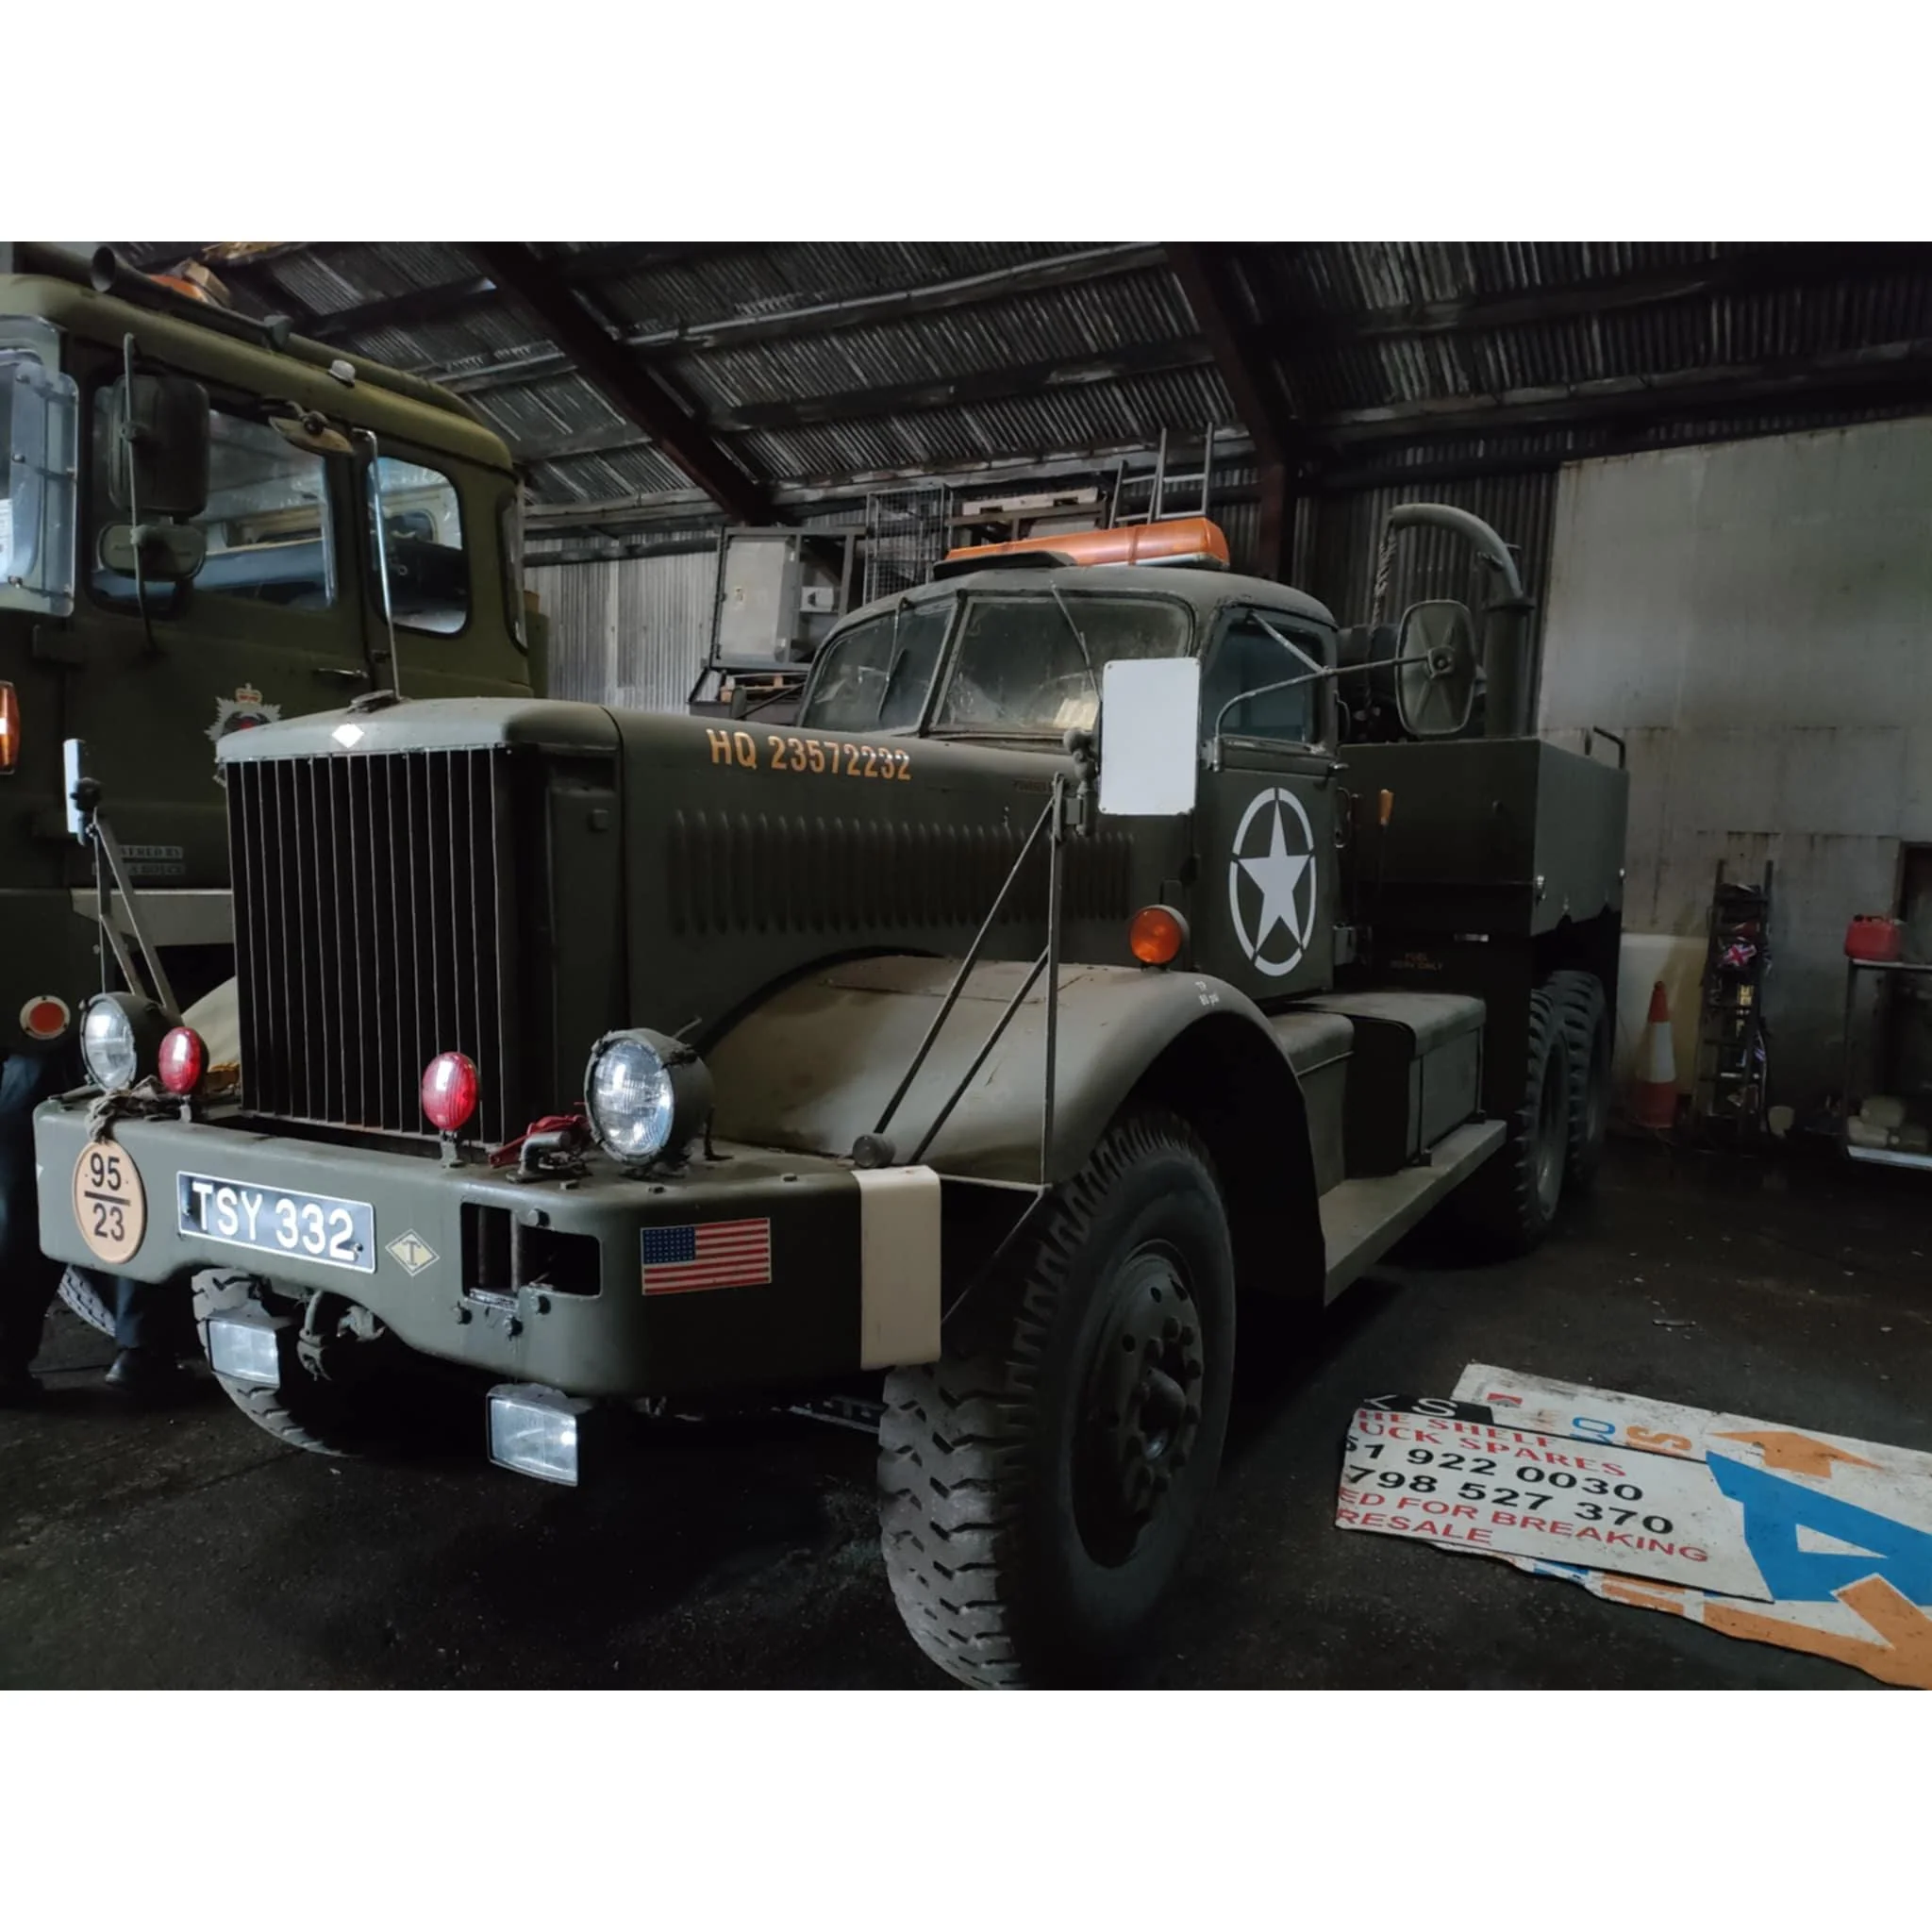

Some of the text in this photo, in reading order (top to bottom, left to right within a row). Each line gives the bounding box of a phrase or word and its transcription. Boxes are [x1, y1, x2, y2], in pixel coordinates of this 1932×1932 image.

[707, 729, 911, 780] HQ 23572232
[91, 1153, 121, 1191] 95
[93, 1204, 125, 1241] 23
[192, 1181, 359, 1262] TSY 332
[1359, 1422, 1626, 1477] UCK SPARES
[1427, 1418, 1555, 1447] SHELF
[1349, 1464, 1674, 1534] 798 527 370
[1407, 1449, 1497, 1475] 922
[1516, 1466, 1643, 1501] 0030
[1337, 1509, 1493, 1545] RESALE
[1396, 1497, 1479, 1520] FOR
[1491, 1510, 1708, 1562] BREAKING
